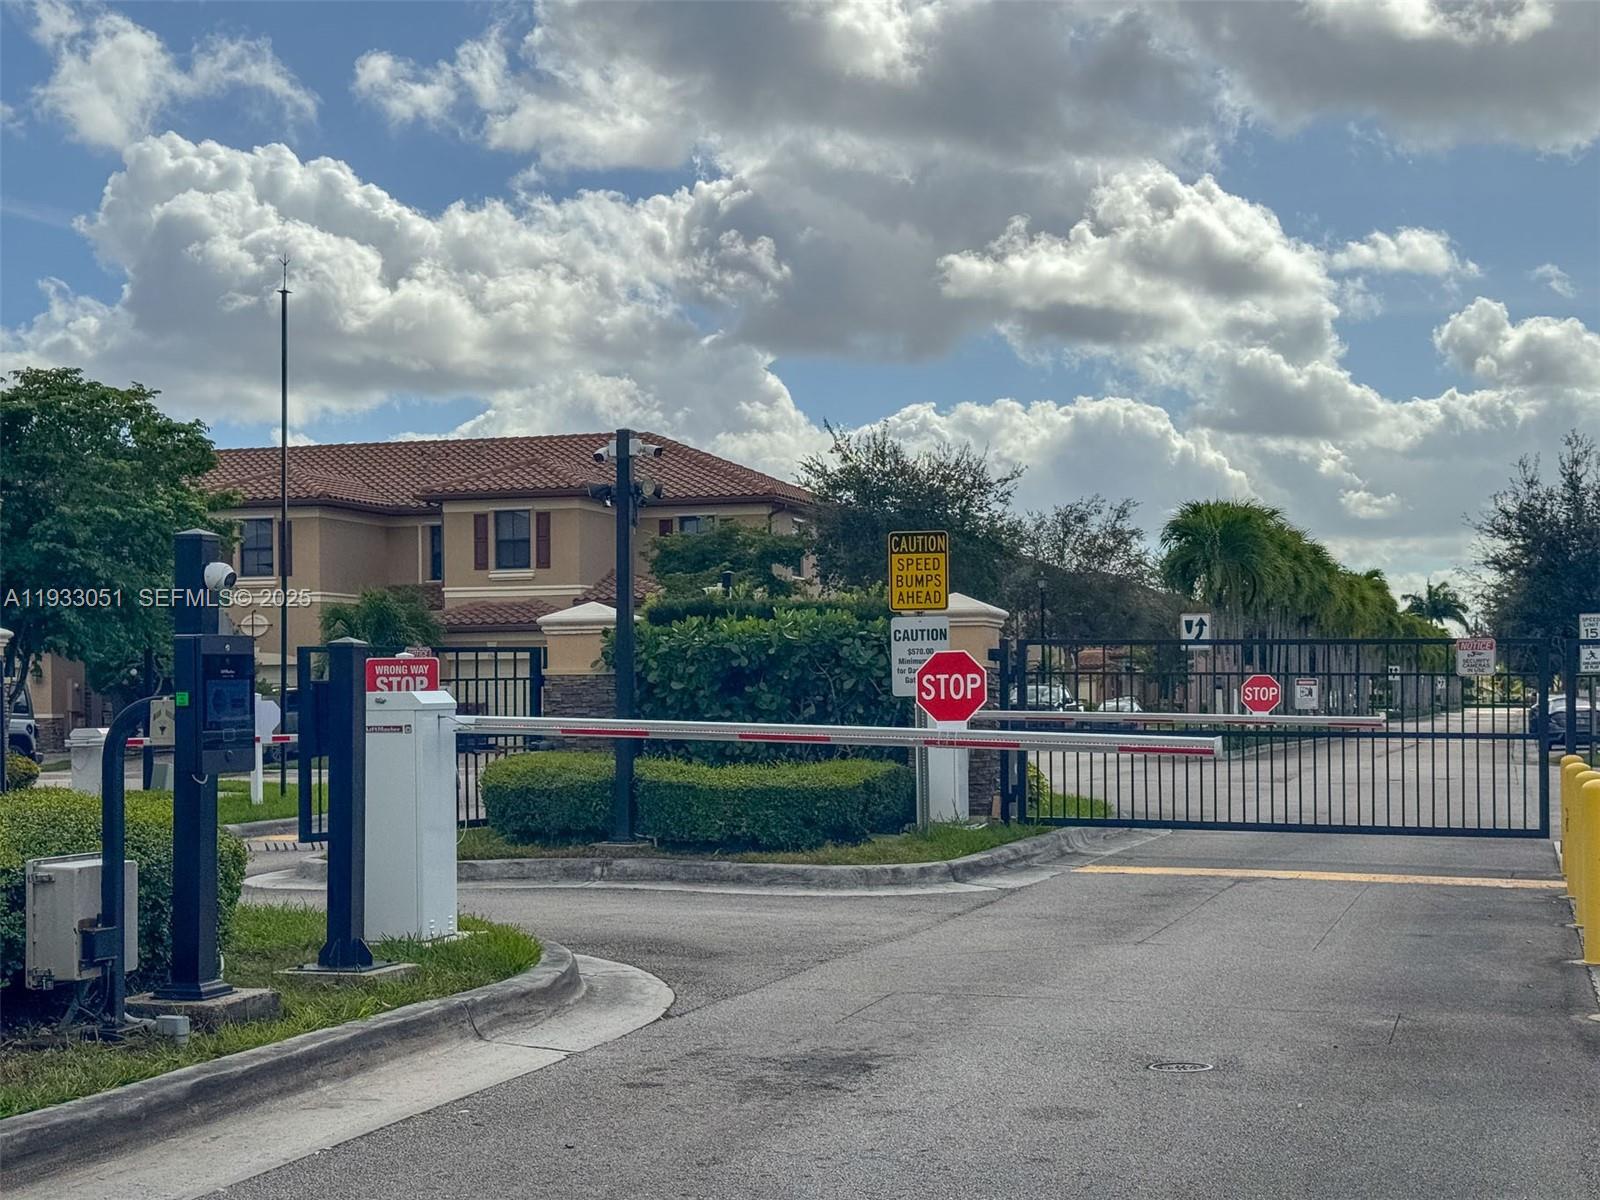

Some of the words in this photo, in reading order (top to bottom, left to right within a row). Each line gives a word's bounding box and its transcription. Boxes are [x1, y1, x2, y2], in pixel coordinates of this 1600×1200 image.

[891, 535, 945, 552] CAUTION
[897, 557, 940, 571] SPEED
[896, 574, 941, 588] BUMPS
[897, 590, 941, 604] AHEAD
[893, 628, 947, 642] CAUTION
[1585, 628, 1598, 638] 15
[907, 648, 934, 656] $570.00
[1460, 641, 1491, 650] NOTICE
[375, 665, 408, 675] WRONG
[410, 665, 429, 675] WAY
[376, 676, 429, 693] STOP
[921, 673, 982, 700] STOP
[1244, 687, 1278, 701] STOP
